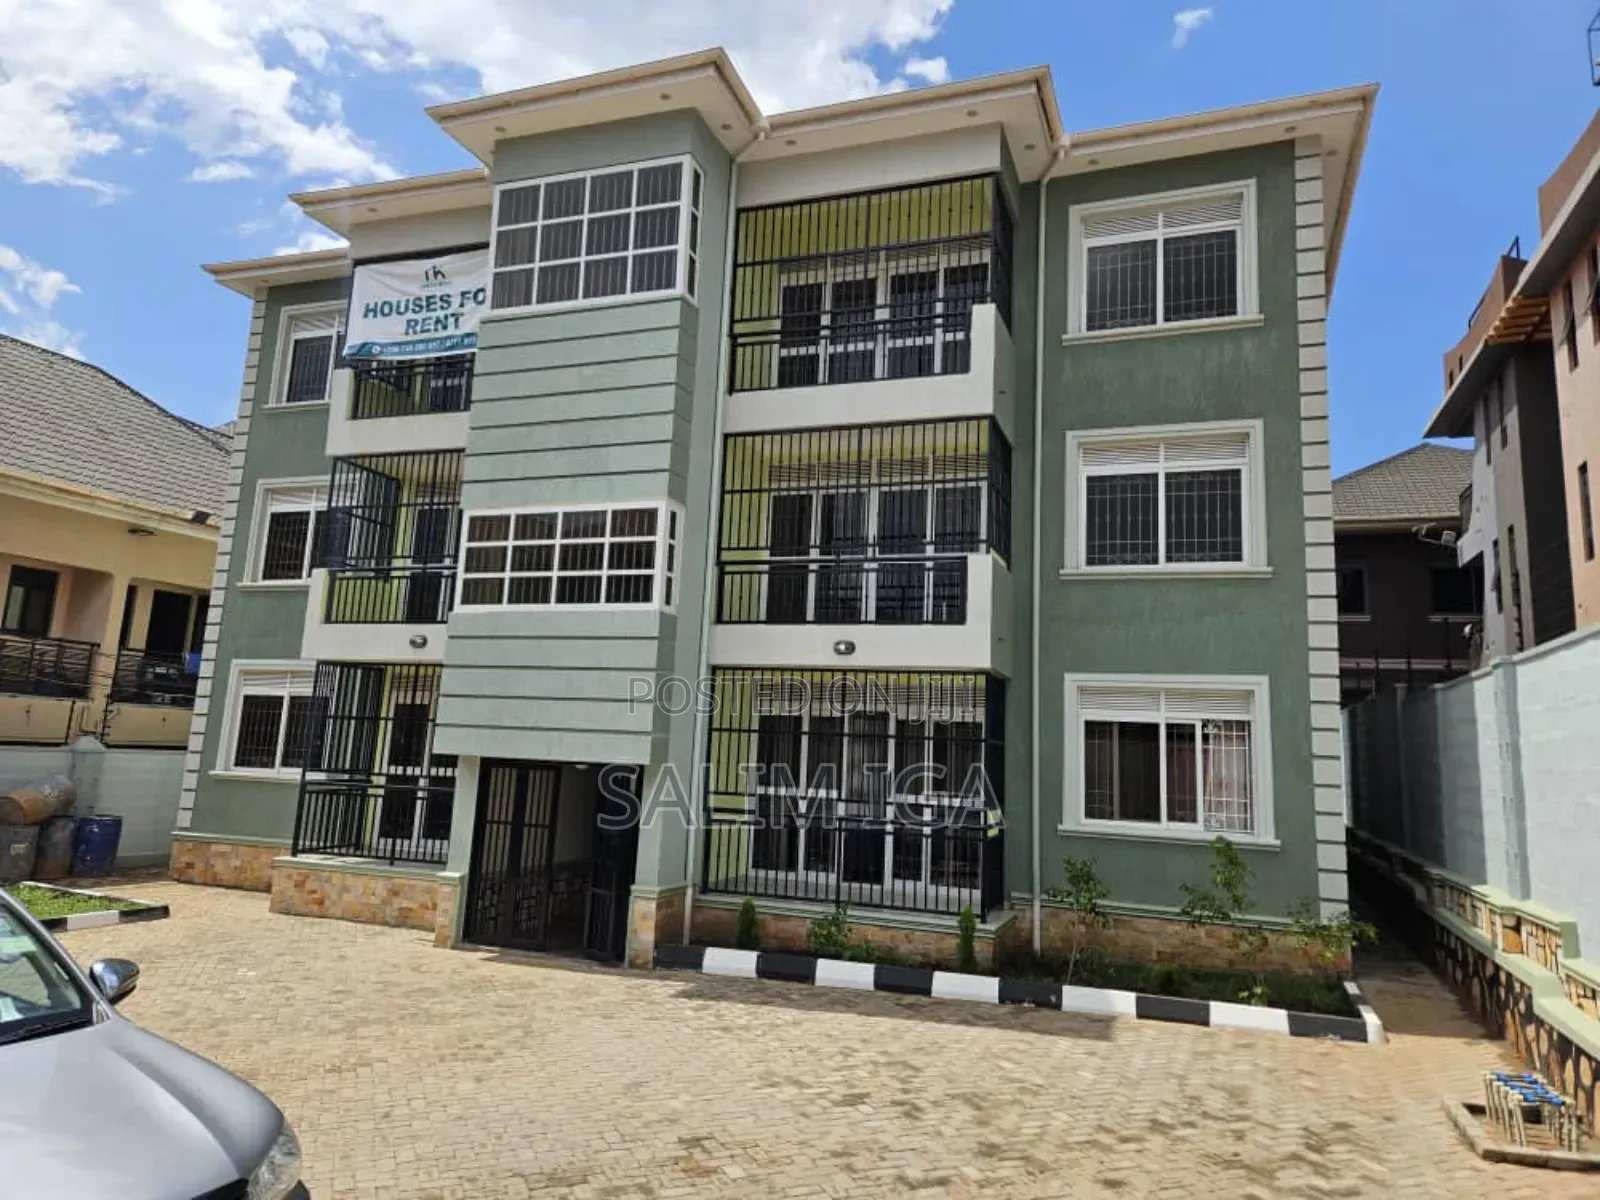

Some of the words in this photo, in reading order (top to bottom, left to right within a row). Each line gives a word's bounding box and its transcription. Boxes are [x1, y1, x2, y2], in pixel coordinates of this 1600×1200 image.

[363, 294, 453, 319] HOUSES
[459, 287, 486, 308] FO
[405, 313, 464, 336] RENT
